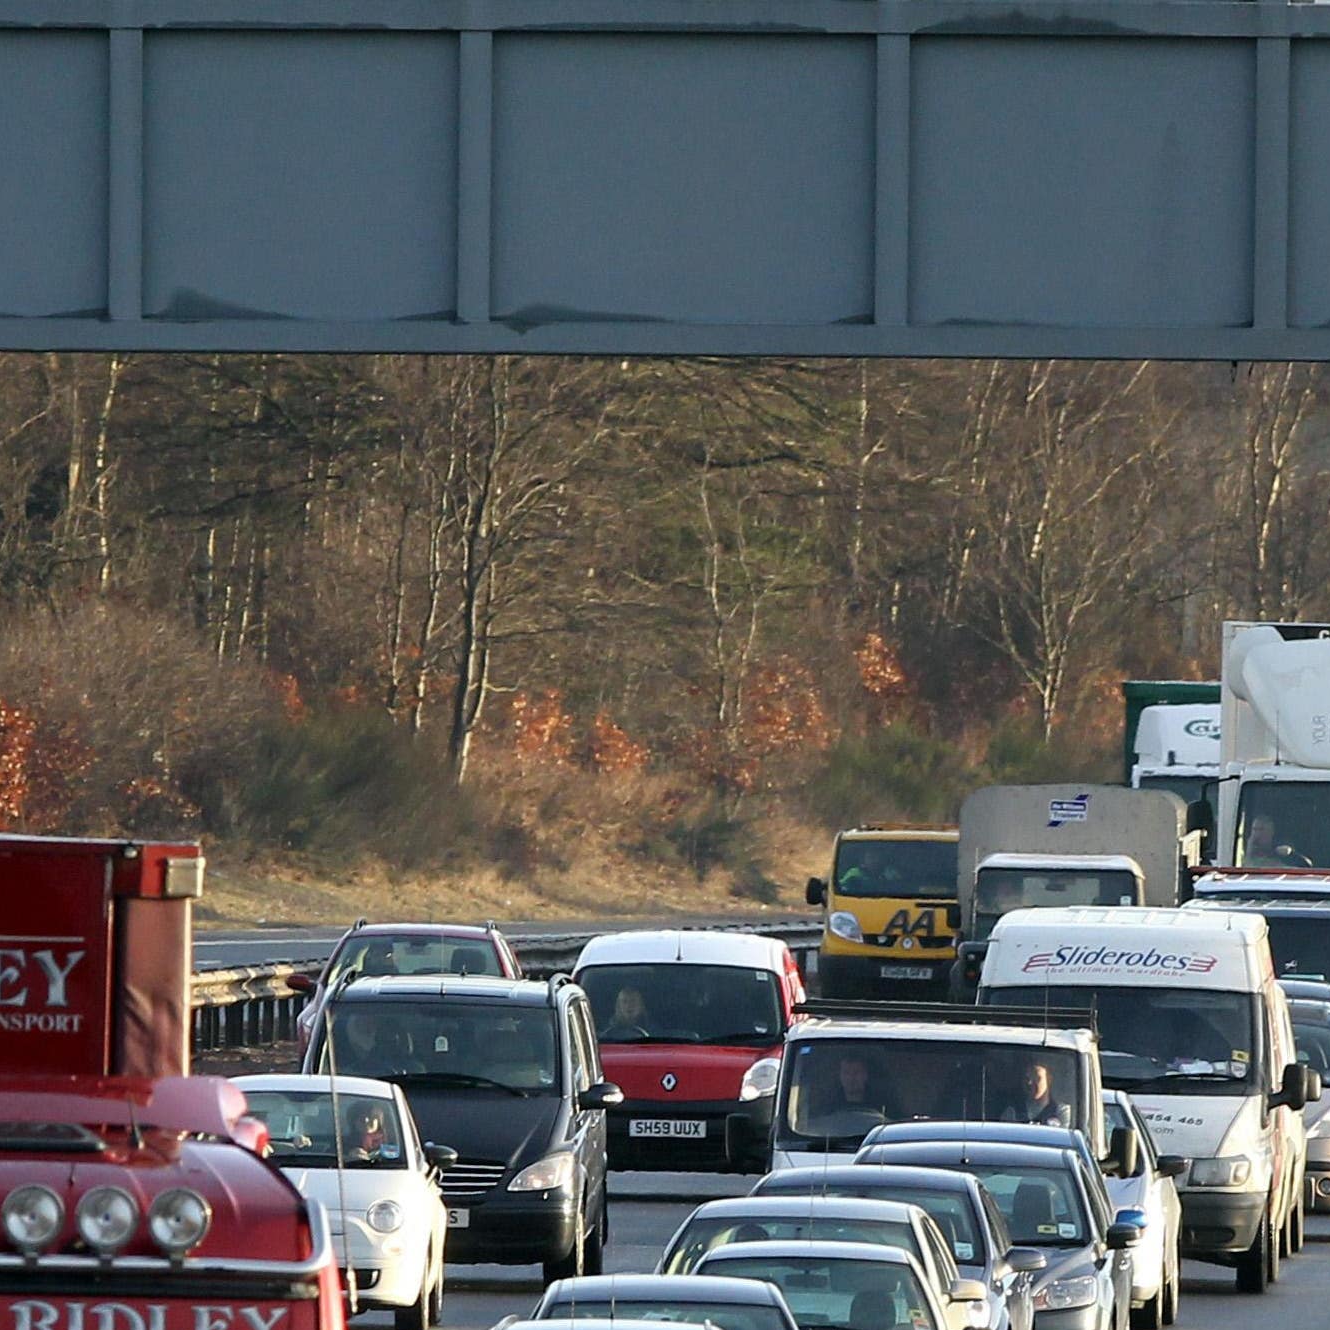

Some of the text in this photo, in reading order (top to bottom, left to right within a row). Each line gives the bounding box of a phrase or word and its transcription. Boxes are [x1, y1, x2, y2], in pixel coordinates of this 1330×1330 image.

[1312, 715, 1327, 745] YOUR
[882, 908, 936, 936] AA
[1049, 946, 1191, 970] Sliderobes
[1070, 966, 1120, 974] ultimate
[636, 1121, 700, 1136] SH59 UUX
[1178, 1116, 1204, 1126] 465
